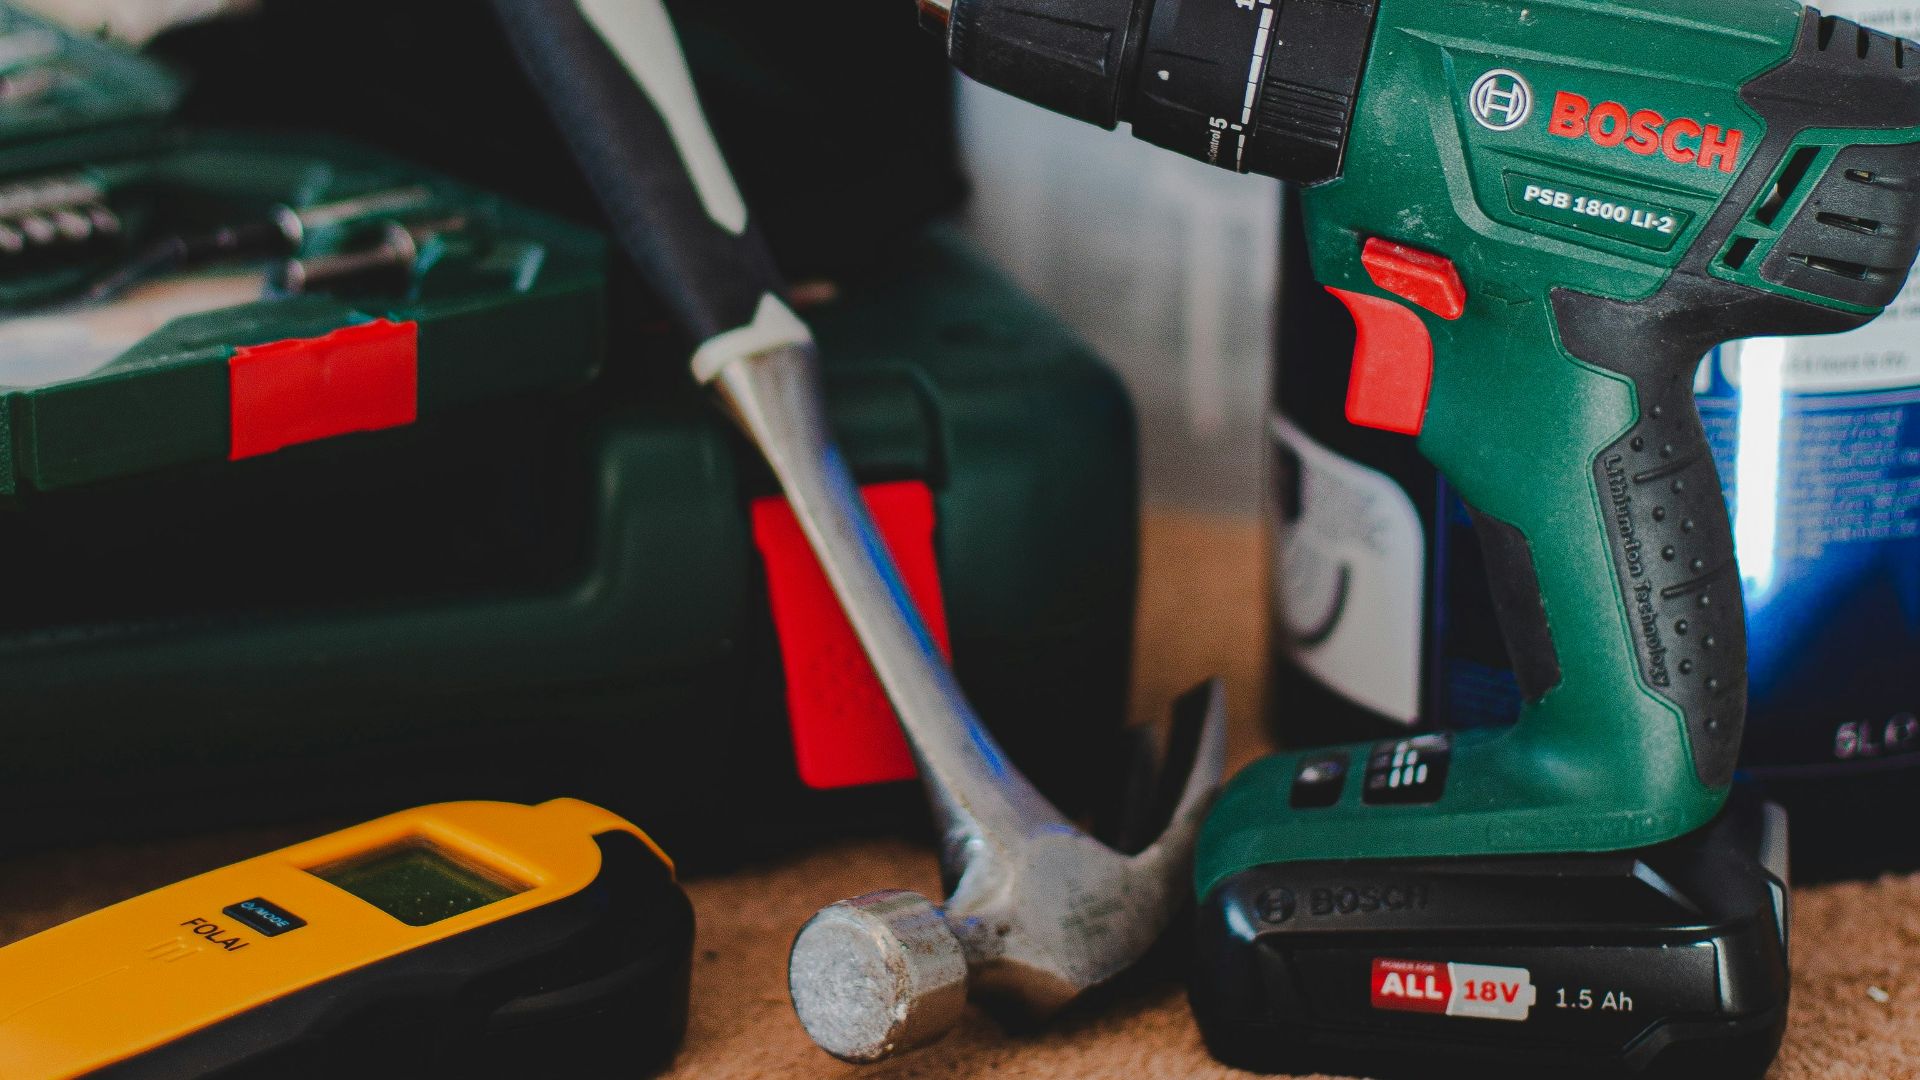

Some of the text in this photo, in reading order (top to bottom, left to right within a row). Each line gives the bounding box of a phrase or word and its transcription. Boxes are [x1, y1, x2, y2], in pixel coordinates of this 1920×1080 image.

[1209, 116, 1228, 131] 5
[1548, 90, 1743, 173] BOSCH
[1207, 129, 1222, 162] Control
[1523, 184, 1676, 234] PSB 1800 LI-2
[1633, 580, 1670, 688] Technology
[1310, 885, 1429, 916] BOSCH
[180, 917, 250, 952] FOLAI
[1380, 971, 1520, 1004] ALL 18V
[1555, 988, 1634, 1012] 1.5 Ah
